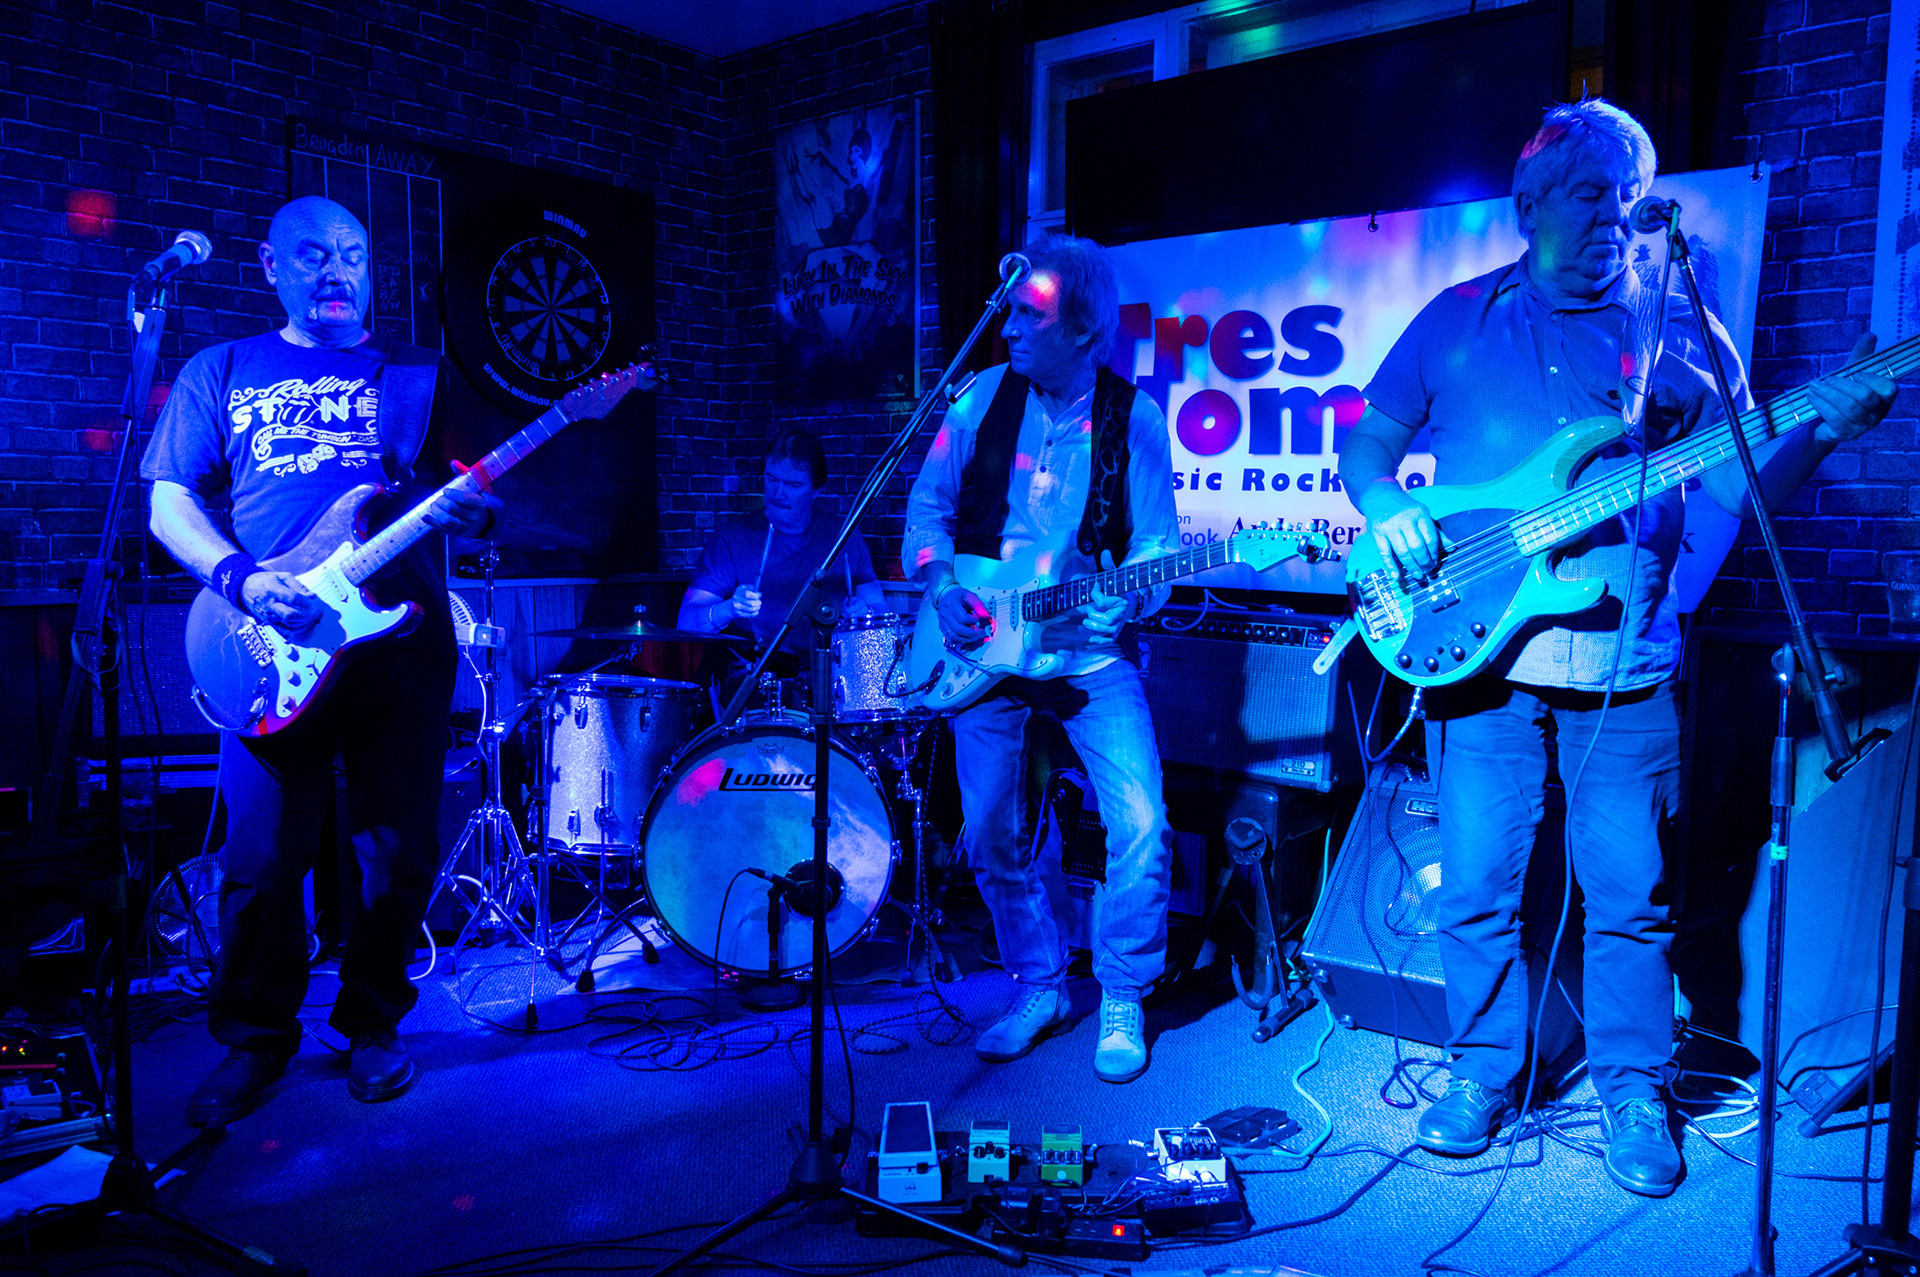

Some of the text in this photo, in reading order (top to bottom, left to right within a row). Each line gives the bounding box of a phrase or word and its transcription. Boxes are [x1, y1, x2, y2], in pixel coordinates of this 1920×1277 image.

[375, 143, 437, 176] AWAY
[783, 254, 906, 297] LUCY IN THE SKY
[791, 282, 896, 318] WITH DIAMONDS
[268, 376, 368, 398] Rolling
[483, 362, 561, 407] www.winmau.c
[1172, 467, 1342, 492] sic Rock
[1180, 528, 1218, 547] ook
[1305, 518, 1363, 546] Ber
